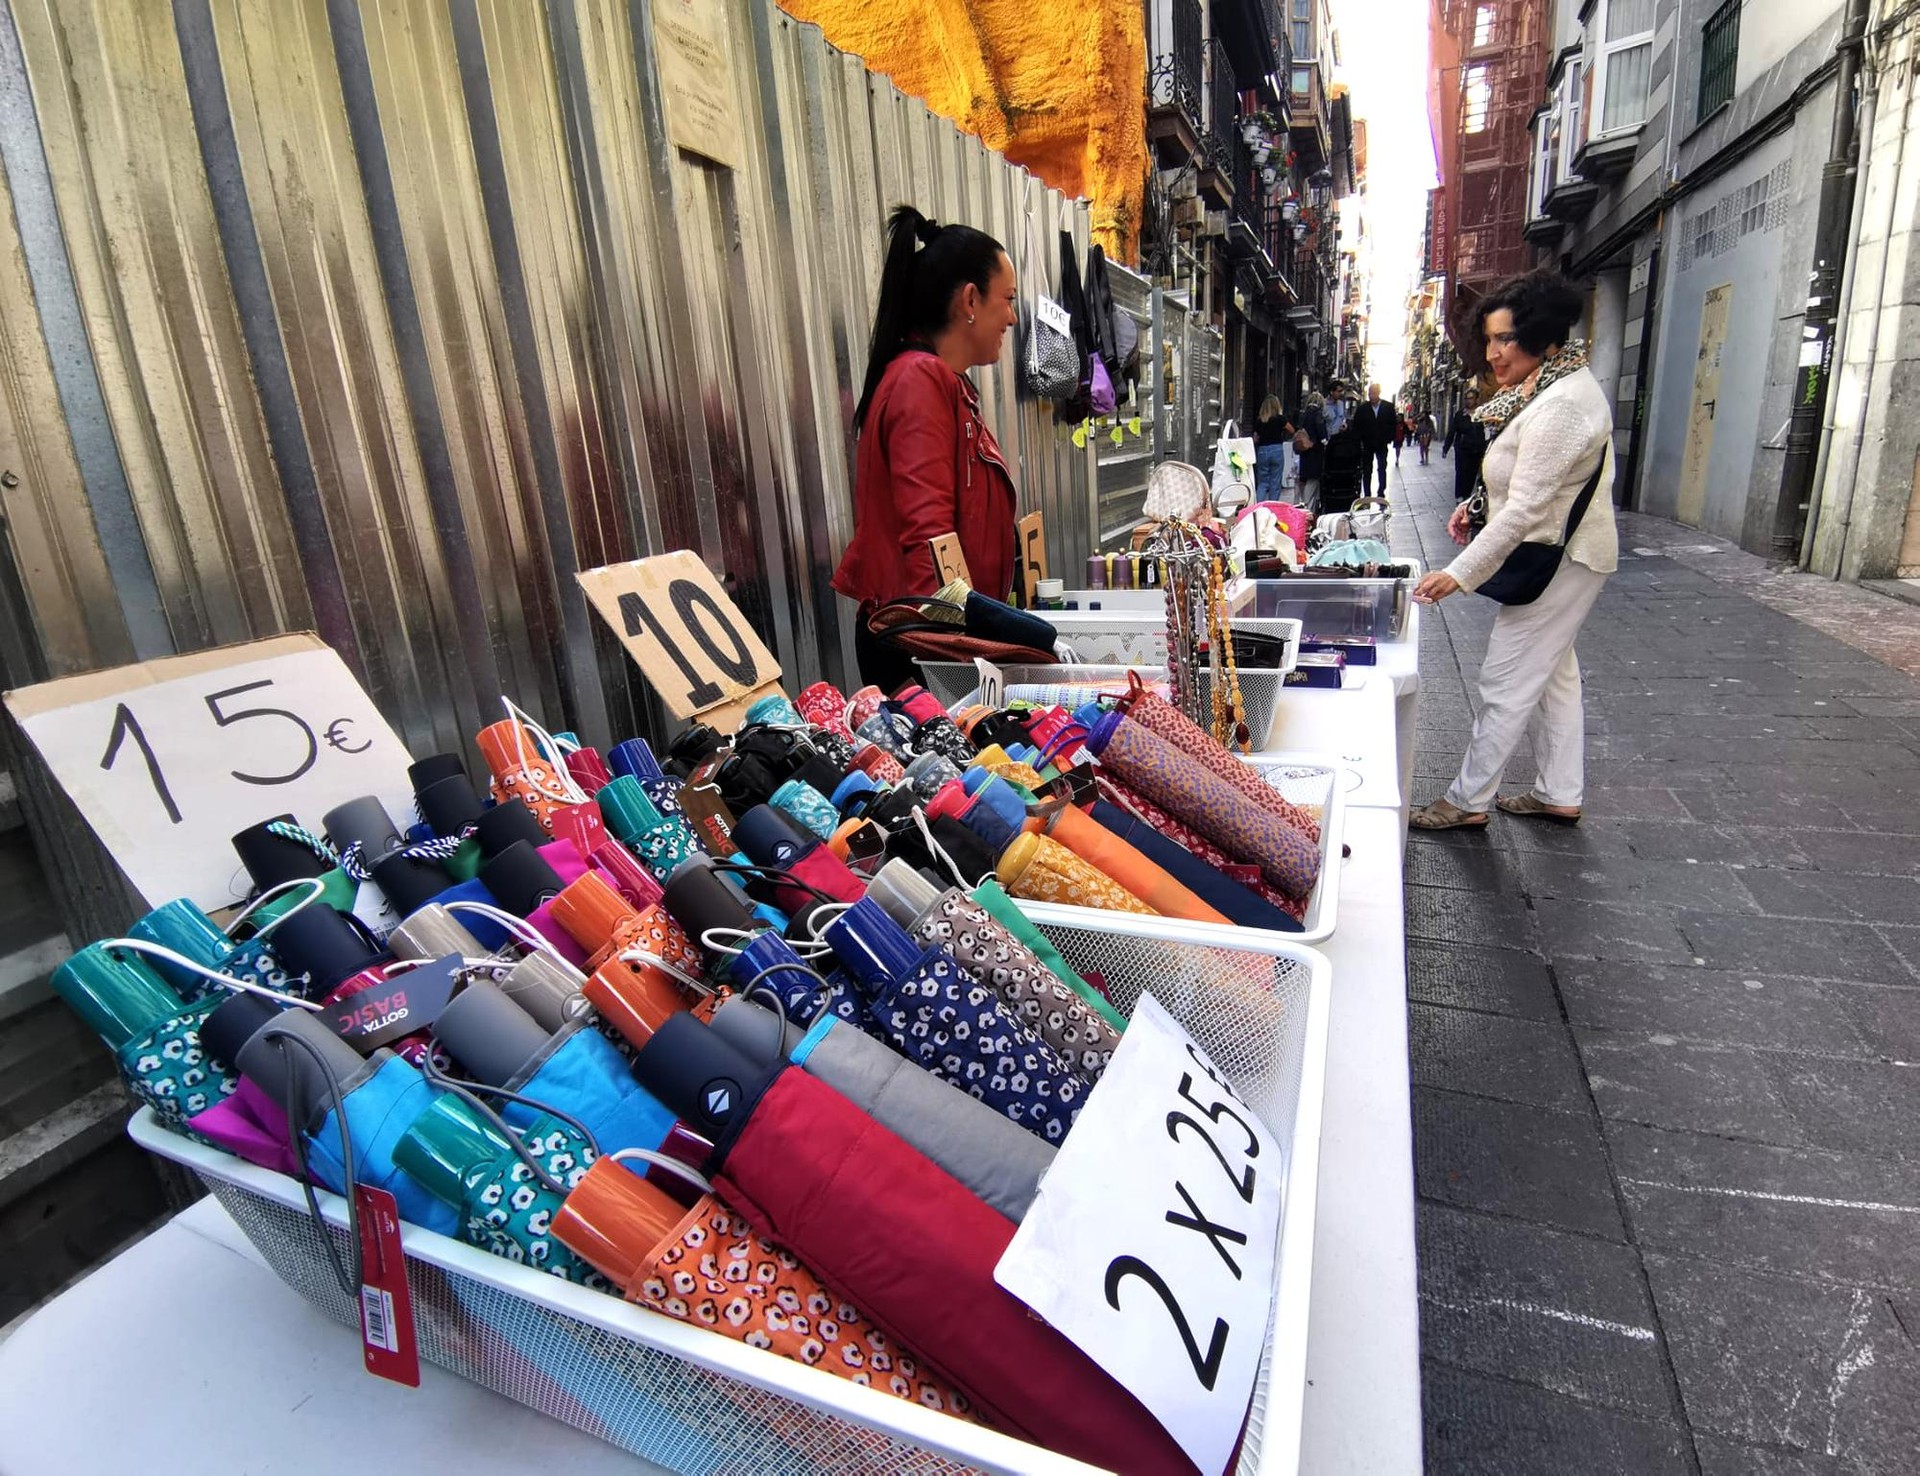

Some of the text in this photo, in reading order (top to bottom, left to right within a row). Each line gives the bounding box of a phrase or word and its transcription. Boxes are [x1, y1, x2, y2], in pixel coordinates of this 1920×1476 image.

[617, 579, 758, 709] 10
[704, 815, 734, 854] BASIC
[714, 813, 732, 838] GOTTA
[338, 991, 408, 1034] BASIC
[363, 1007, 409, 1034] GOTTA
[1104, 1254, 1230, 1392] 2
